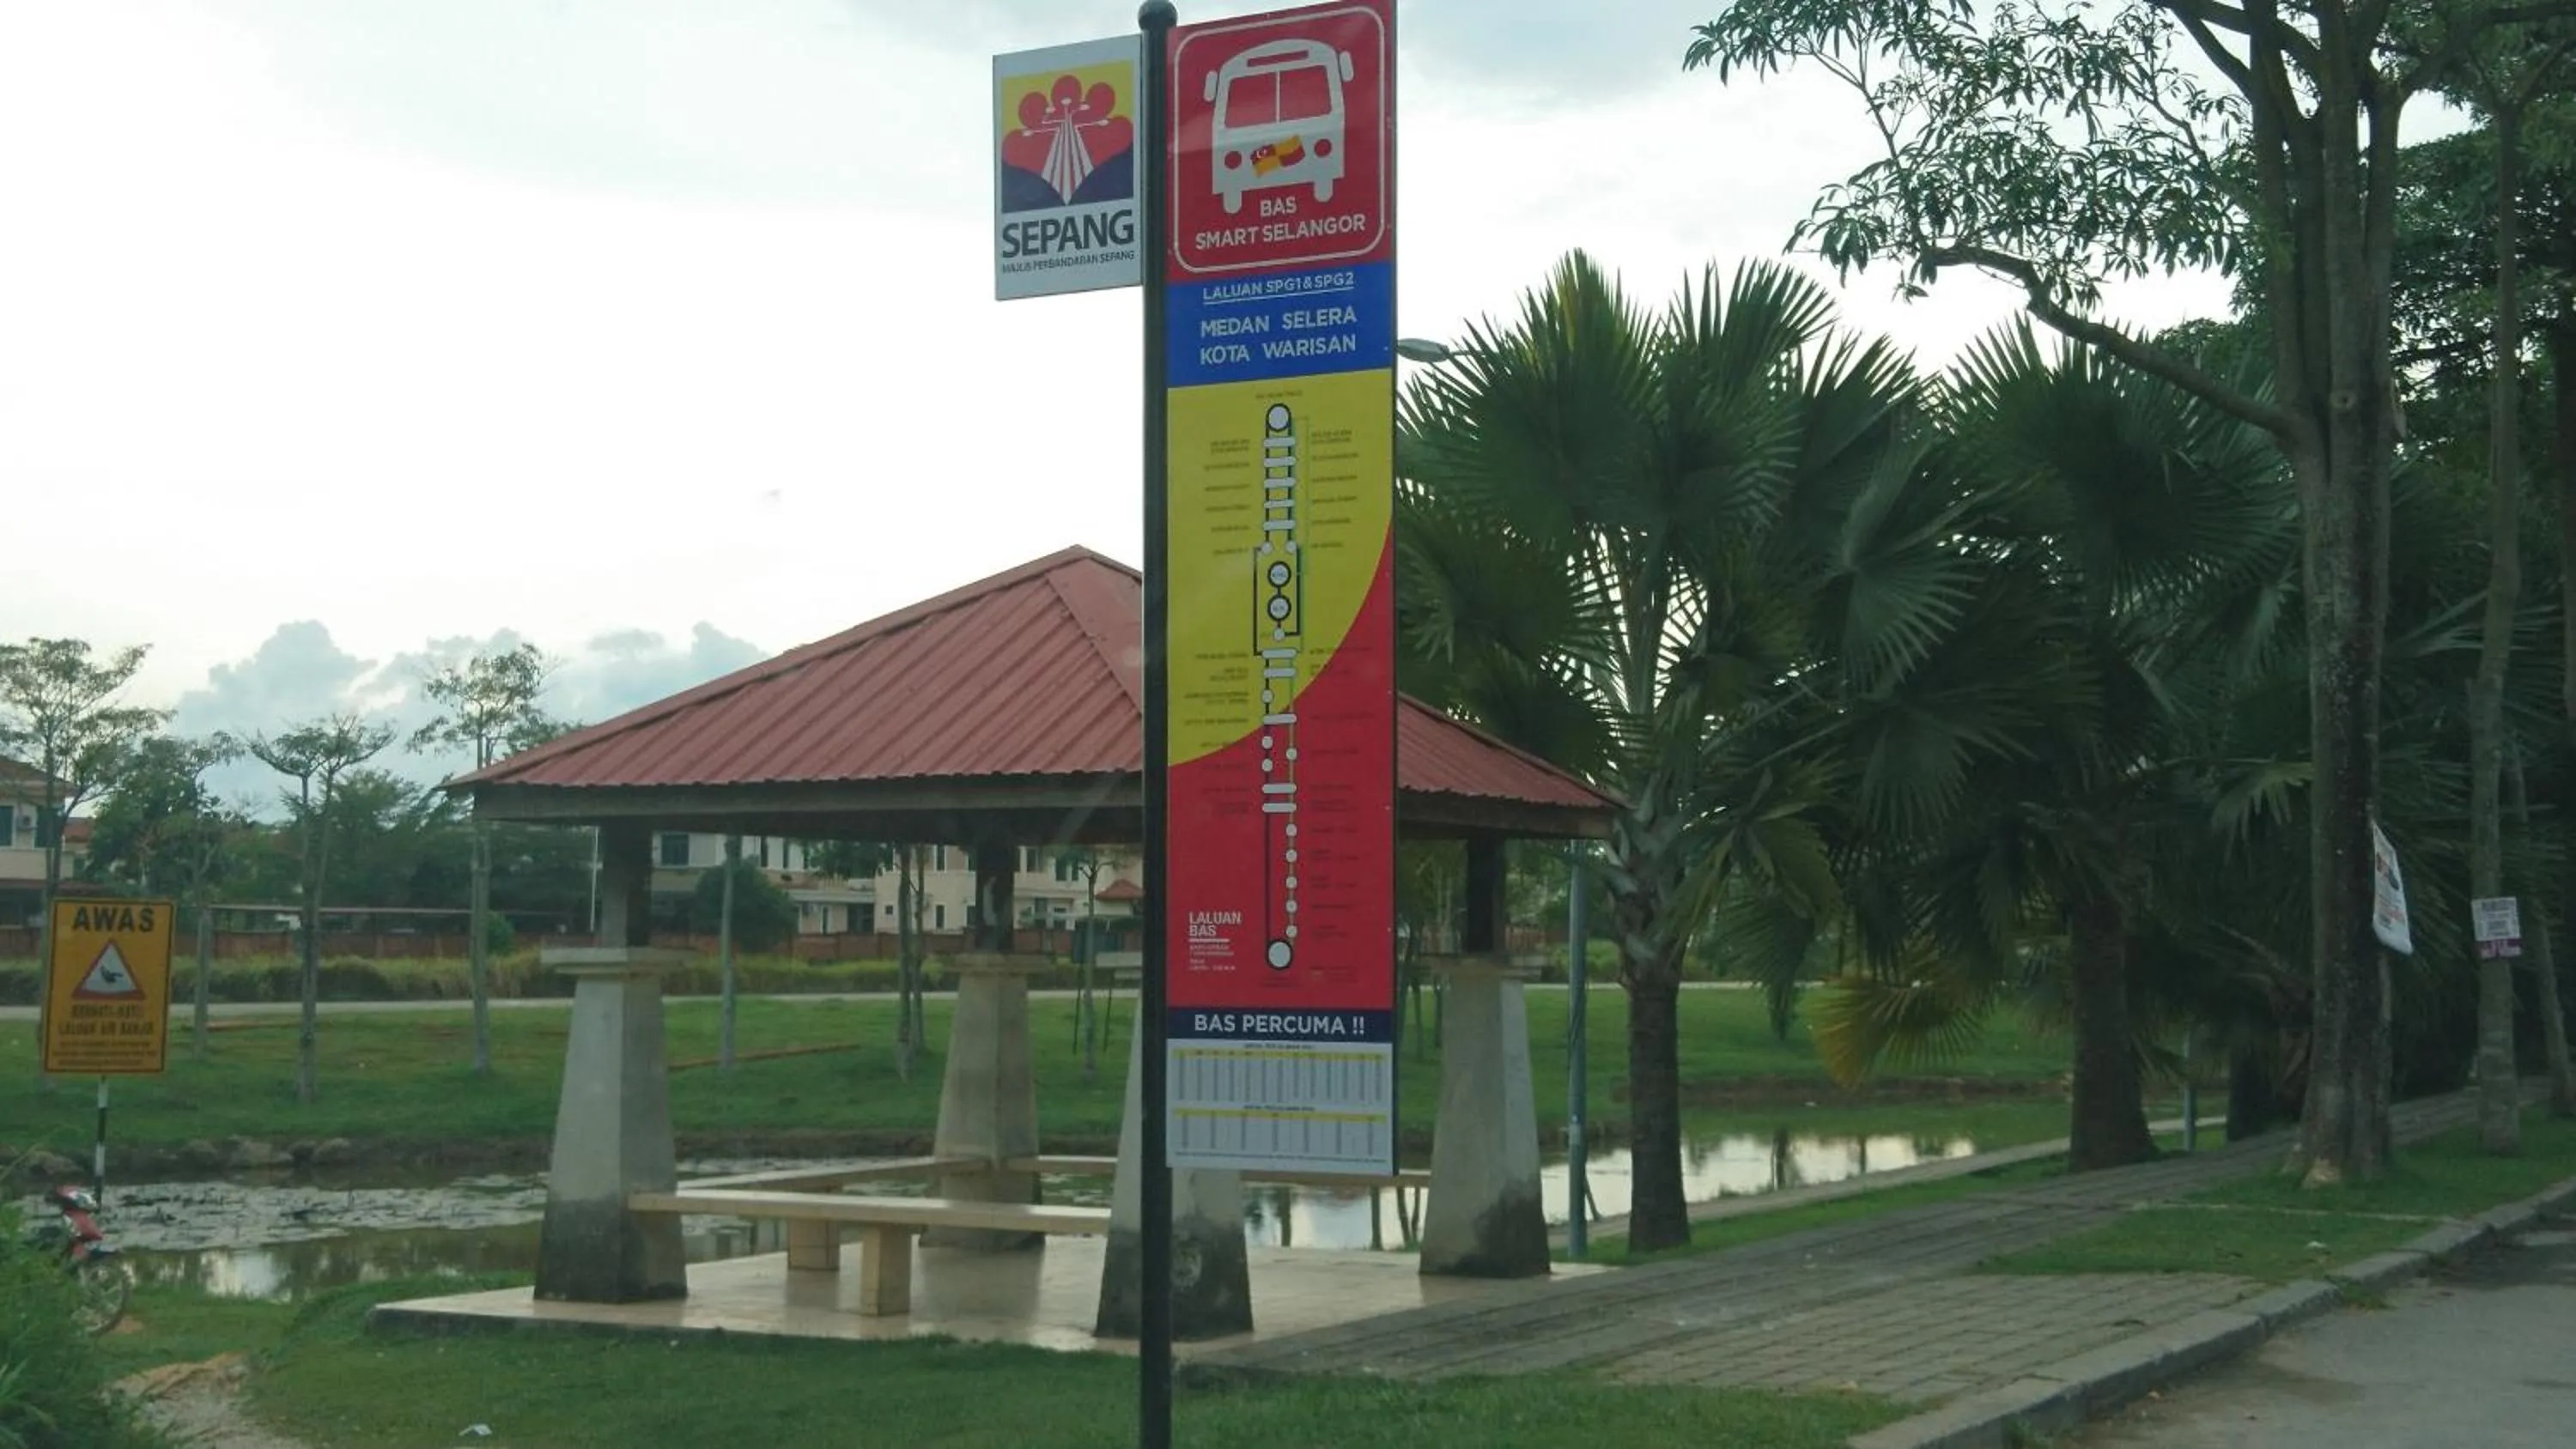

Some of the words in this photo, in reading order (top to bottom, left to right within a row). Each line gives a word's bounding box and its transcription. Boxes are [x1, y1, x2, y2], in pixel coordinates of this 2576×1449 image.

[1260, 197, 1297, 217] BAS
[1002, 209, 1134, 258] SEPANG
[1195, 226, 1260, 251] SMART
[1262, 213, 1366, 243] SELANGOR
[1202, 283, 1262, 300] LALUAN
[1200, 315, 1270, 338] MEDAN
[1282, 305, 1358, 330] SELERA
[1200, 345, 1250, 366] KOTA
[1262, 334, 1357, 359] WARISAN
[72, 906, 155, 933] AWAS
[1188, 911, 1242, 925] LALUAN
[1188, 925, 1217, 937] BAS
[1194, 1014, 1236, 1032] BAS
[1242, 1015, 1346, 1035] PERCUMA
[1352, 1016, 1365, 1035] !!
